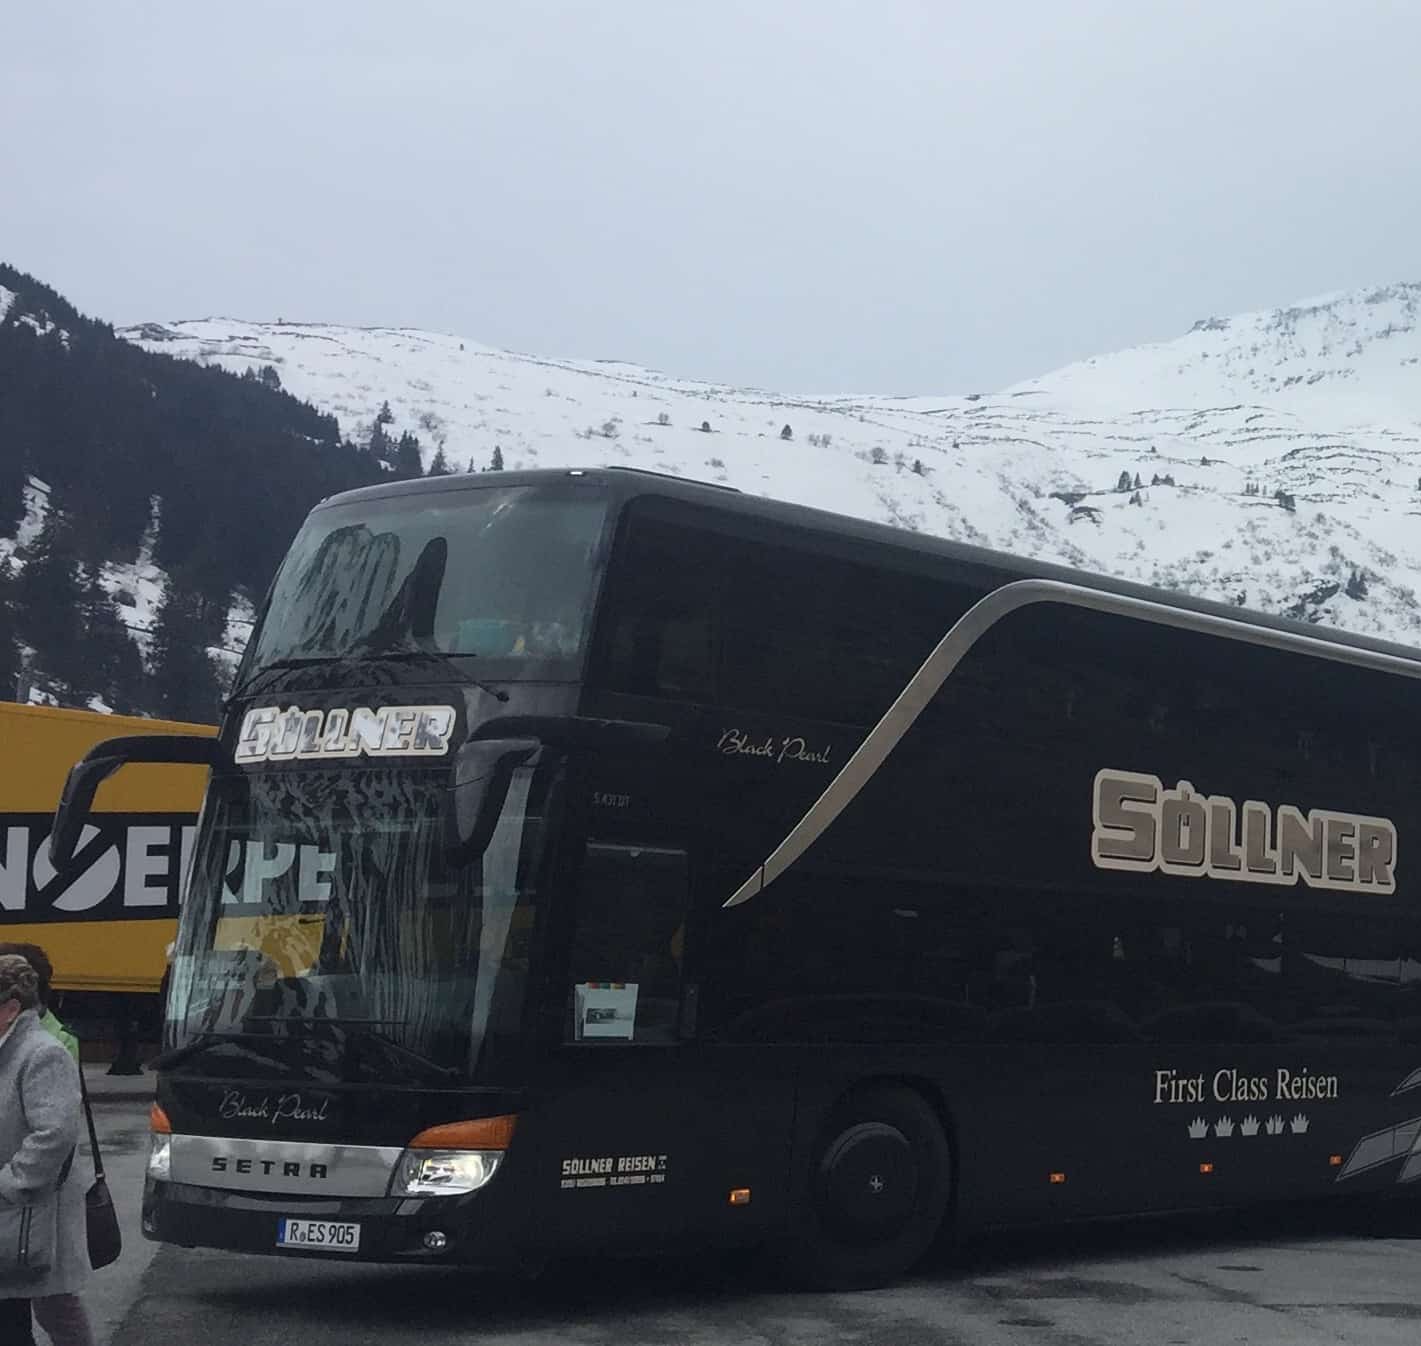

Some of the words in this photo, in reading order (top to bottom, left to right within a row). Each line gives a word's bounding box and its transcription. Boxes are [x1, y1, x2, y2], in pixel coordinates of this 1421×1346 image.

[717, 727, 773, 757] Black
[777, 736, 832, 763] Pearl
[1153, 1069, 1205, 1104] First
[1213, 1069, 1268, 1102] Class
[1275, 1067, 1339, 1100] Reisen
[219, 1089, 268, 1119] Black
[271, 1093, 329, 1124] Pearl
[211, 1157, 328, 1179] SETRA
[618, 1155, 656, 1172] REISEN
